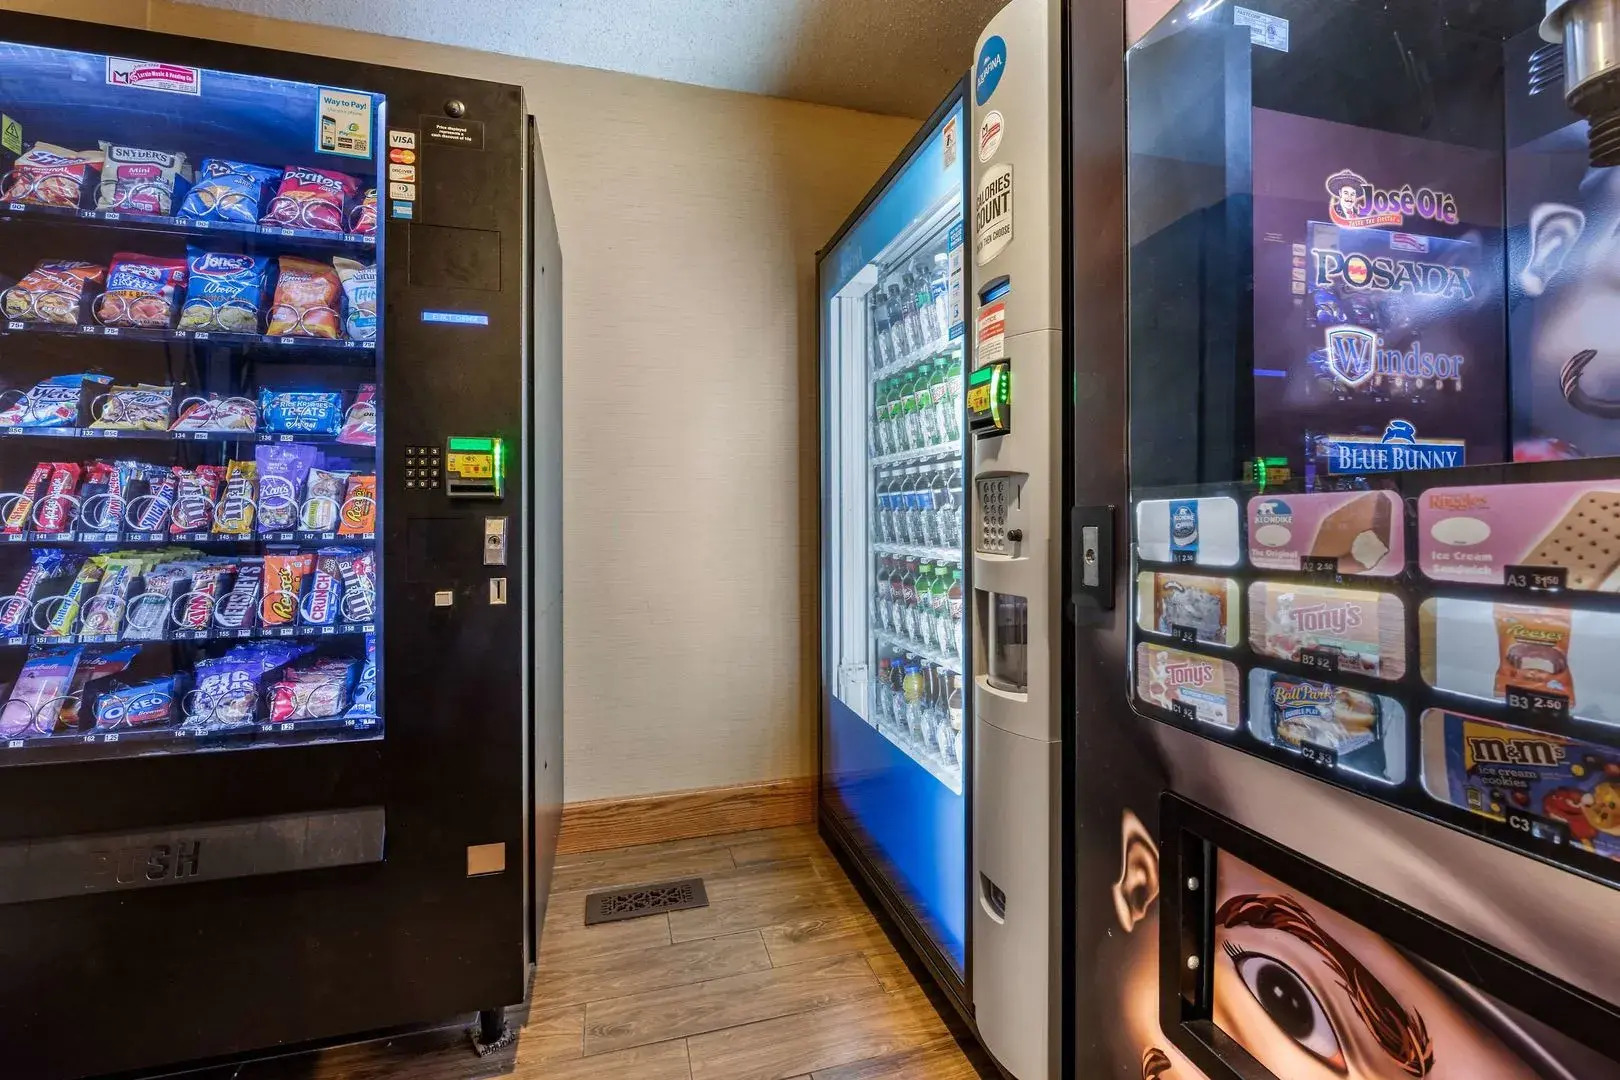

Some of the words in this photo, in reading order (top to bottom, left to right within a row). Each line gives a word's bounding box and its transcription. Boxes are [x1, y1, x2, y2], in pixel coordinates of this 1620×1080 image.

[324, 97, 340, 106] Way
[350, 101, 366, 110] Pay!
[392, 136, 413, 145] VISA
[116, 149, 167, 162] SNYDER'S
[284, 171, 343, 190] Doritos
[976, 172, 1010, 211] CALORIES
[976, 190, 1010, 233] COUNT
[200, 254, 244, 270] Jones
[1312, 249, 1475, 300] POSADA
[1332, 336, 1464, 379] Windsor
[282, 407, 326, 417] TREATS
[1338, 446, 1388, 470] BLUE
[1392, 447, 1458, 470] BUNNY
[261, 483, 289, 497] Kar's
[1432, 552, 1450, 560] Ice
[1454, 552, 1494, 562] Cream
[1303, 562, 1314, 572] A2
[1316, 562, 1334, 571] 2.50
[1432, 564, 1493, 575] Sandwich
[1507, 575, 1527, 587] A3
[272, 568, 293, 619] Reese's
[312, 572, 332, 620] CRUNCH
[1291, 603, 1362, 634] Tony's
[1302, 654, 1314, 665] B2
[202, 670, 250, 690] BIG
[1165, 662, 1212, 687] Tony's
[1275, 686, 1300, 704] Ball
[1300, 684, 1332, 700] Park
[103, 697, 163, 720] OREO
[1509, 695, 1528, 709] B3
[1534, 698, 1562, 710] 2.50
[1302, 748, 1314, 760] C2
[1479, 767, 1494, 776] ice
[1496, 769, 1538, 778] cream
[1482, 776, 1527, 788] cookies
[1510, 816, 1530, 832] C3
